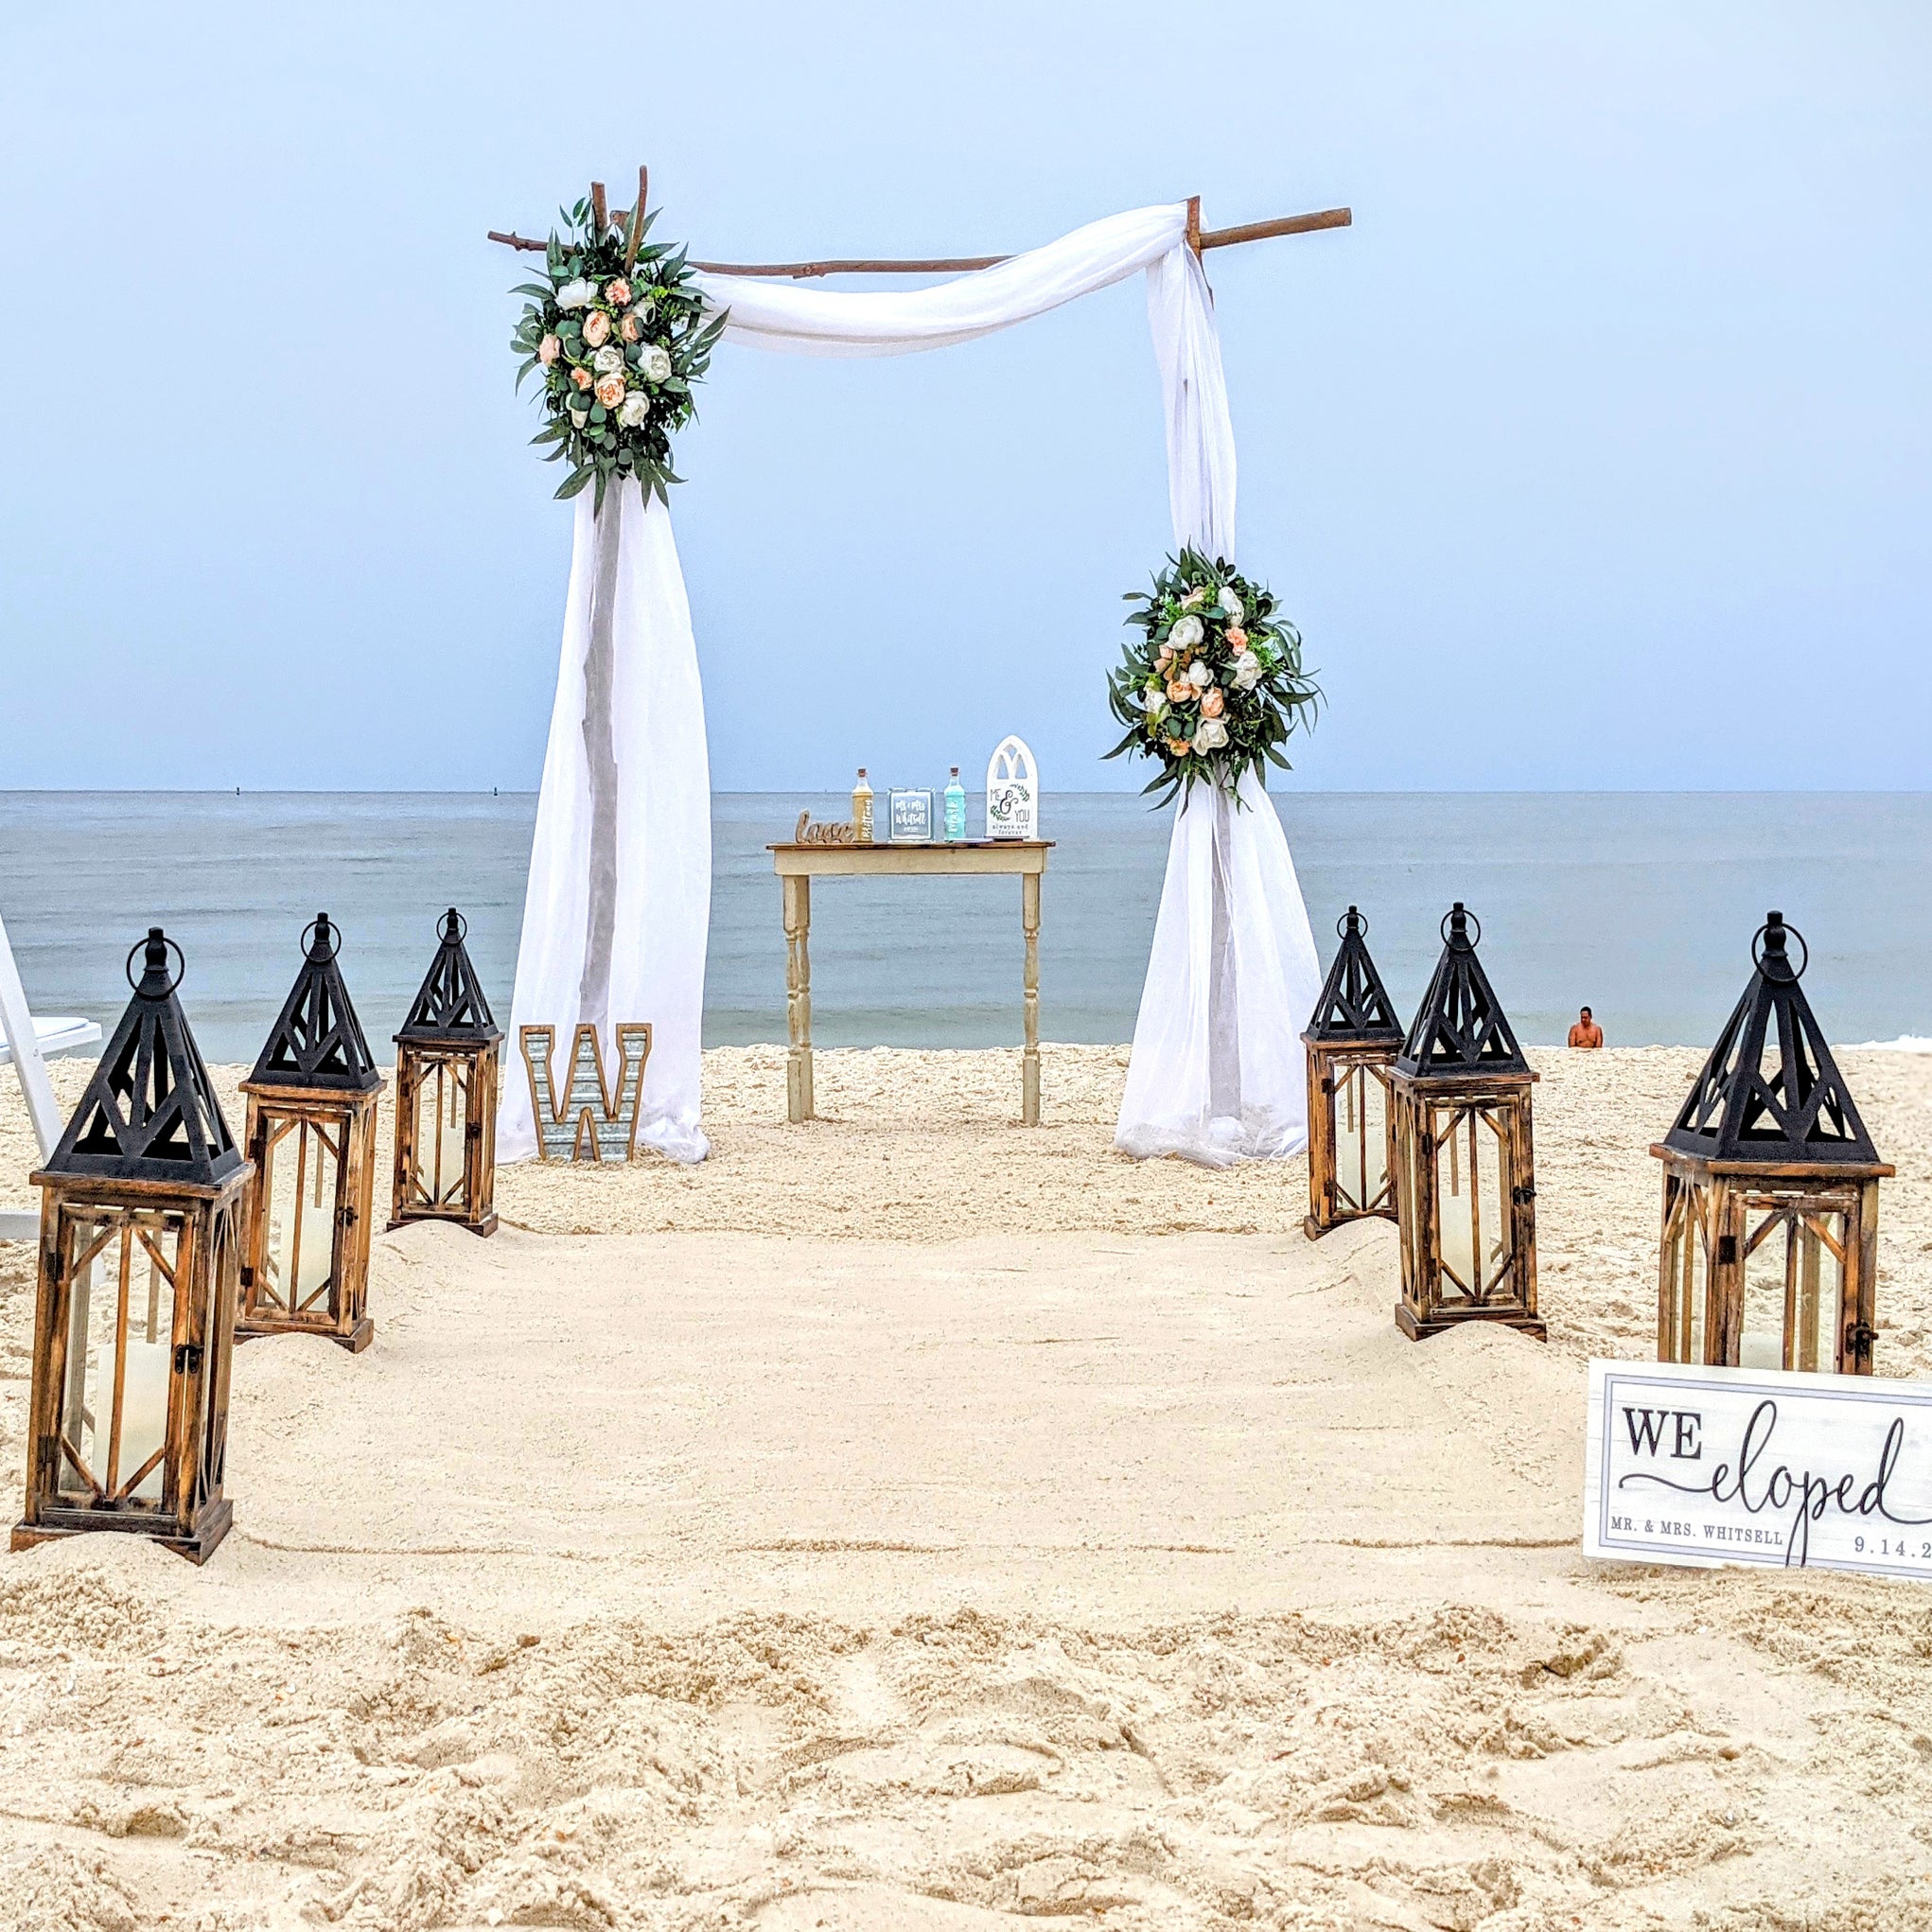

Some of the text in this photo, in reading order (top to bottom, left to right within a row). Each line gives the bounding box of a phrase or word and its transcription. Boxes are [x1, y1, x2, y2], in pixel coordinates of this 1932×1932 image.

[990, 788, 1001, 801] ME
[999, 789, 1019, 815] &
[1014, 809, 1029, 822] YOU
[1622, 1407, 1702, 1460] WE
[1711, 1399, 1932, 1569] eloped
[1610, 1516, 1783, 1545] MR. & MRS. WHITSELL
